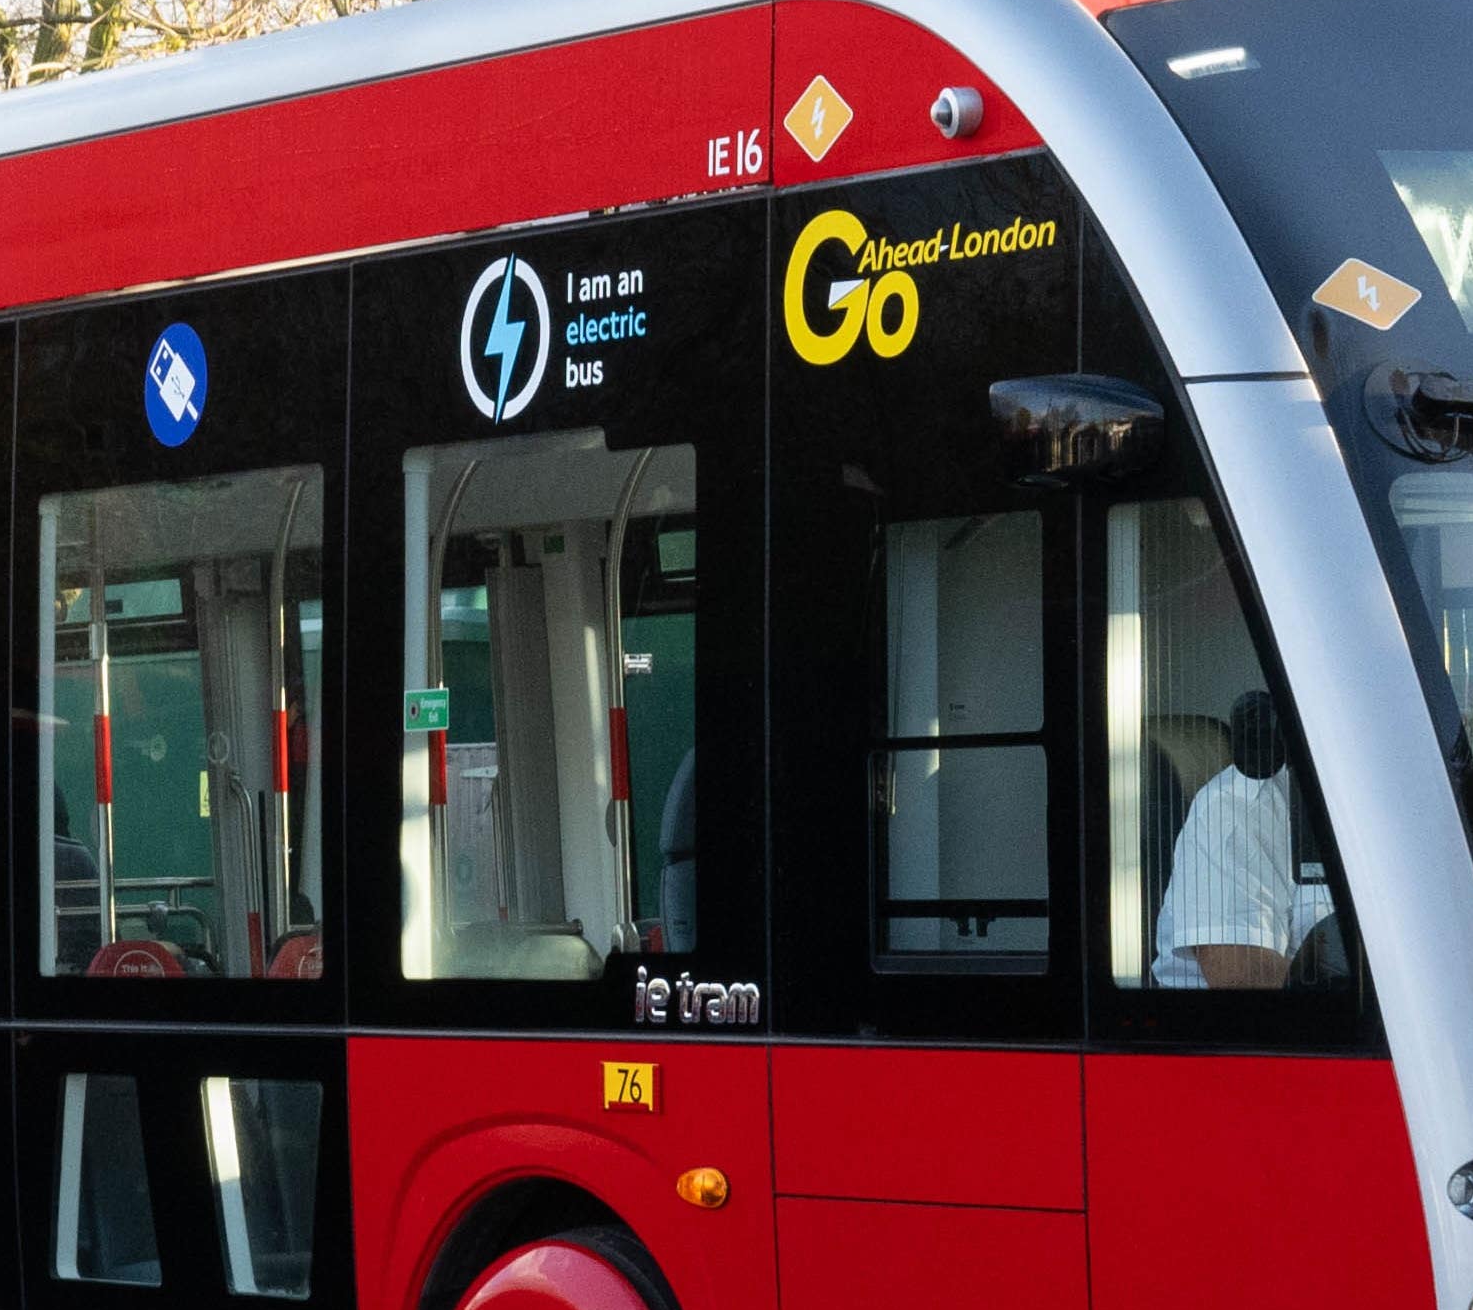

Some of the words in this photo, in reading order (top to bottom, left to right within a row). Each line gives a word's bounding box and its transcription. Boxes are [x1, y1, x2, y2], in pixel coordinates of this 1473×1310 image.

[857, 216, 1056, 274] Ahead-London
[567, 272, 573, 303] I
[579, 274, 611, 302] am
[617, 269, 643, 296] an
[784, 209, 919, 366] Go
[565, 305, 647, 345] electric
[565, 357, 604, 388] bus
[634, 965, 671, 1023] ie
[675, 971, 761, 1024] tram
[617, 1068, 643, 1103] 76
